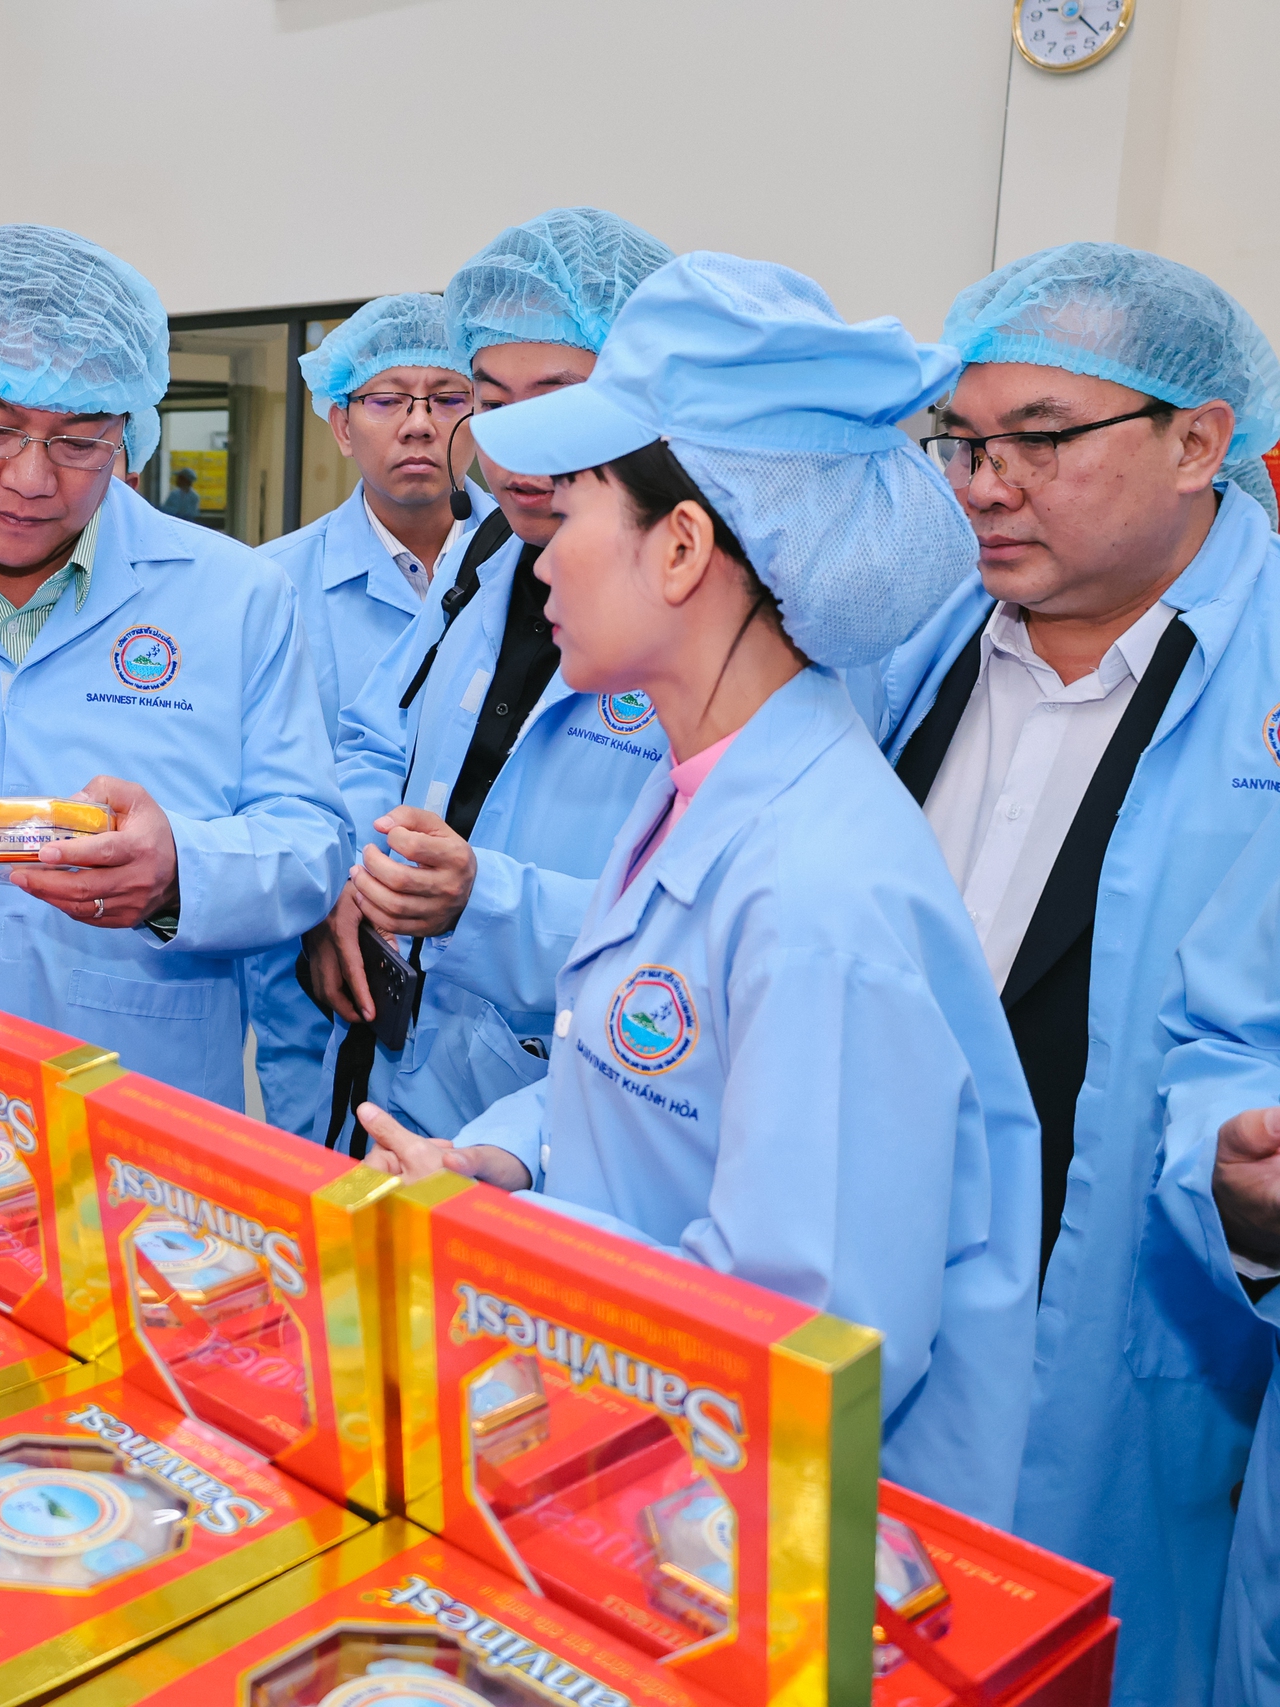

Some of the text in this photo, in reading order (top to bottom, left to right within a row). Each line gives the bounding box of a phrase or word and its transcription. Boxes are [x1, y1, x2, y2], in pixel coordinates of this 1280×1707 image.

[1030, 10, 1043, 22] 9
[1033, 30, 1045, 41] 8
[1099, 21, 1111, 31] 4
[1047, 42, 1057, 53] 7
[1063, 45, 1075, 57] 6
[1083, 37, 1095, 49] 5
[86, 693, 194, 712] SANVINEST KHÁNH HÒA
[567, 727, 610, 746] SANVINEST
[610, 738, 641, 756] KHÁNH
[622, 1076, 666, 1108] KHÁNH
[669, 1099, 699, 1121] HÒA
[109, 1156, 307, 1296] Sanvinest
[457, 1280, 746, 1470] Sanvinest
[65, 1403, 271, 1536] Sanvinest
[392, 1572, 636, 1707] anvinest
